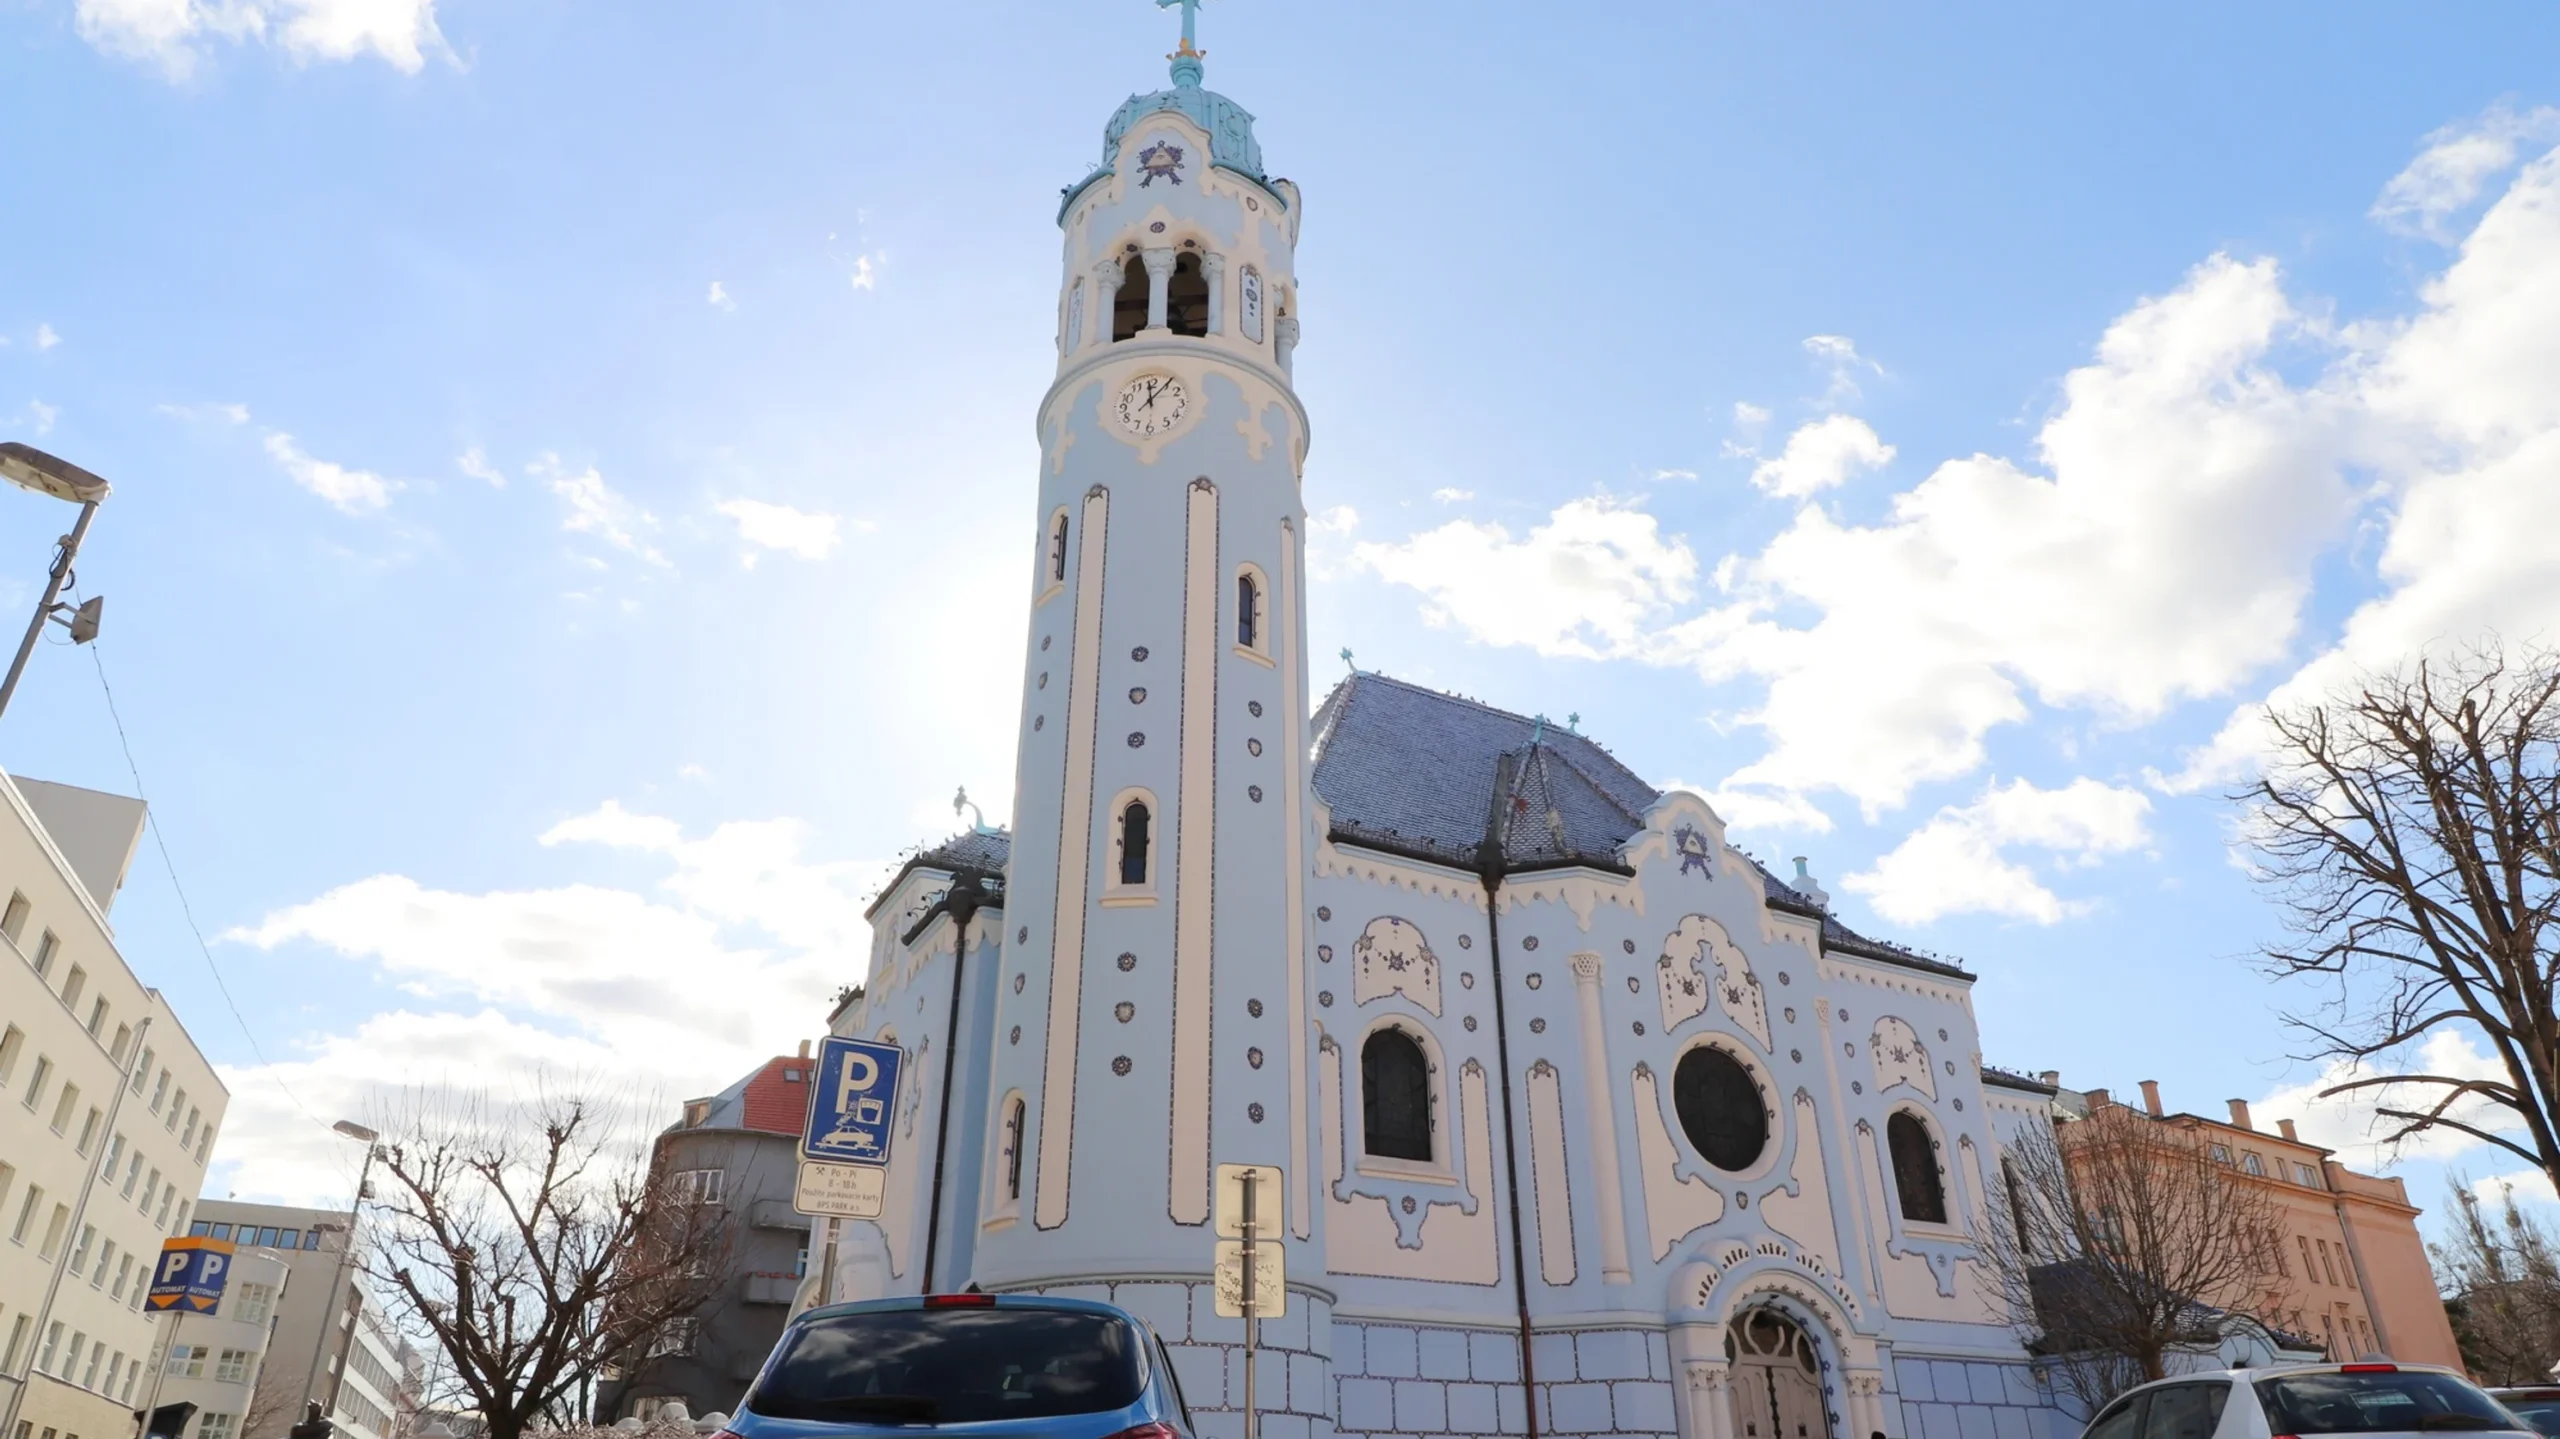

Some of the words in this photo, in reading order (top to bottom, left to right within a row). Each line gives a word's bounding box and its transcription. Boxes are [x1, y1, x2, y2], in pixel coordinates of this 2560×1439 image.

[1131, 382, 1142, 393] 11
[1146, 378, 1158, 389] 12
[1172, 386, 1181, 397] 2
[1122, 393, 1134, 404] 10
[1178, 398, 1185, 409] 3
[1119, 403, 1128, 413] 9
[1123, 412, 1131, 423] 8
[1172, 408, 1180, 420] 4
[1134, 419, 1141, 430] 7
[1145, 420, 1155, 434] 6
[1163, 416, 1170, 428] 5
[835, 1051, 879, 1114] P
[831, 1168, 841, 1177] Po
[828, 1179, 834, 1187] 8
[862, 1193, 880, 1203] karty
[161, 1252, 189, 1283] P
[198, 1253, 223, 1284] P
[150, 1285, 186, 1294] AUTOMAT
[188, 1286, 221, 1298] AUTOMAT
